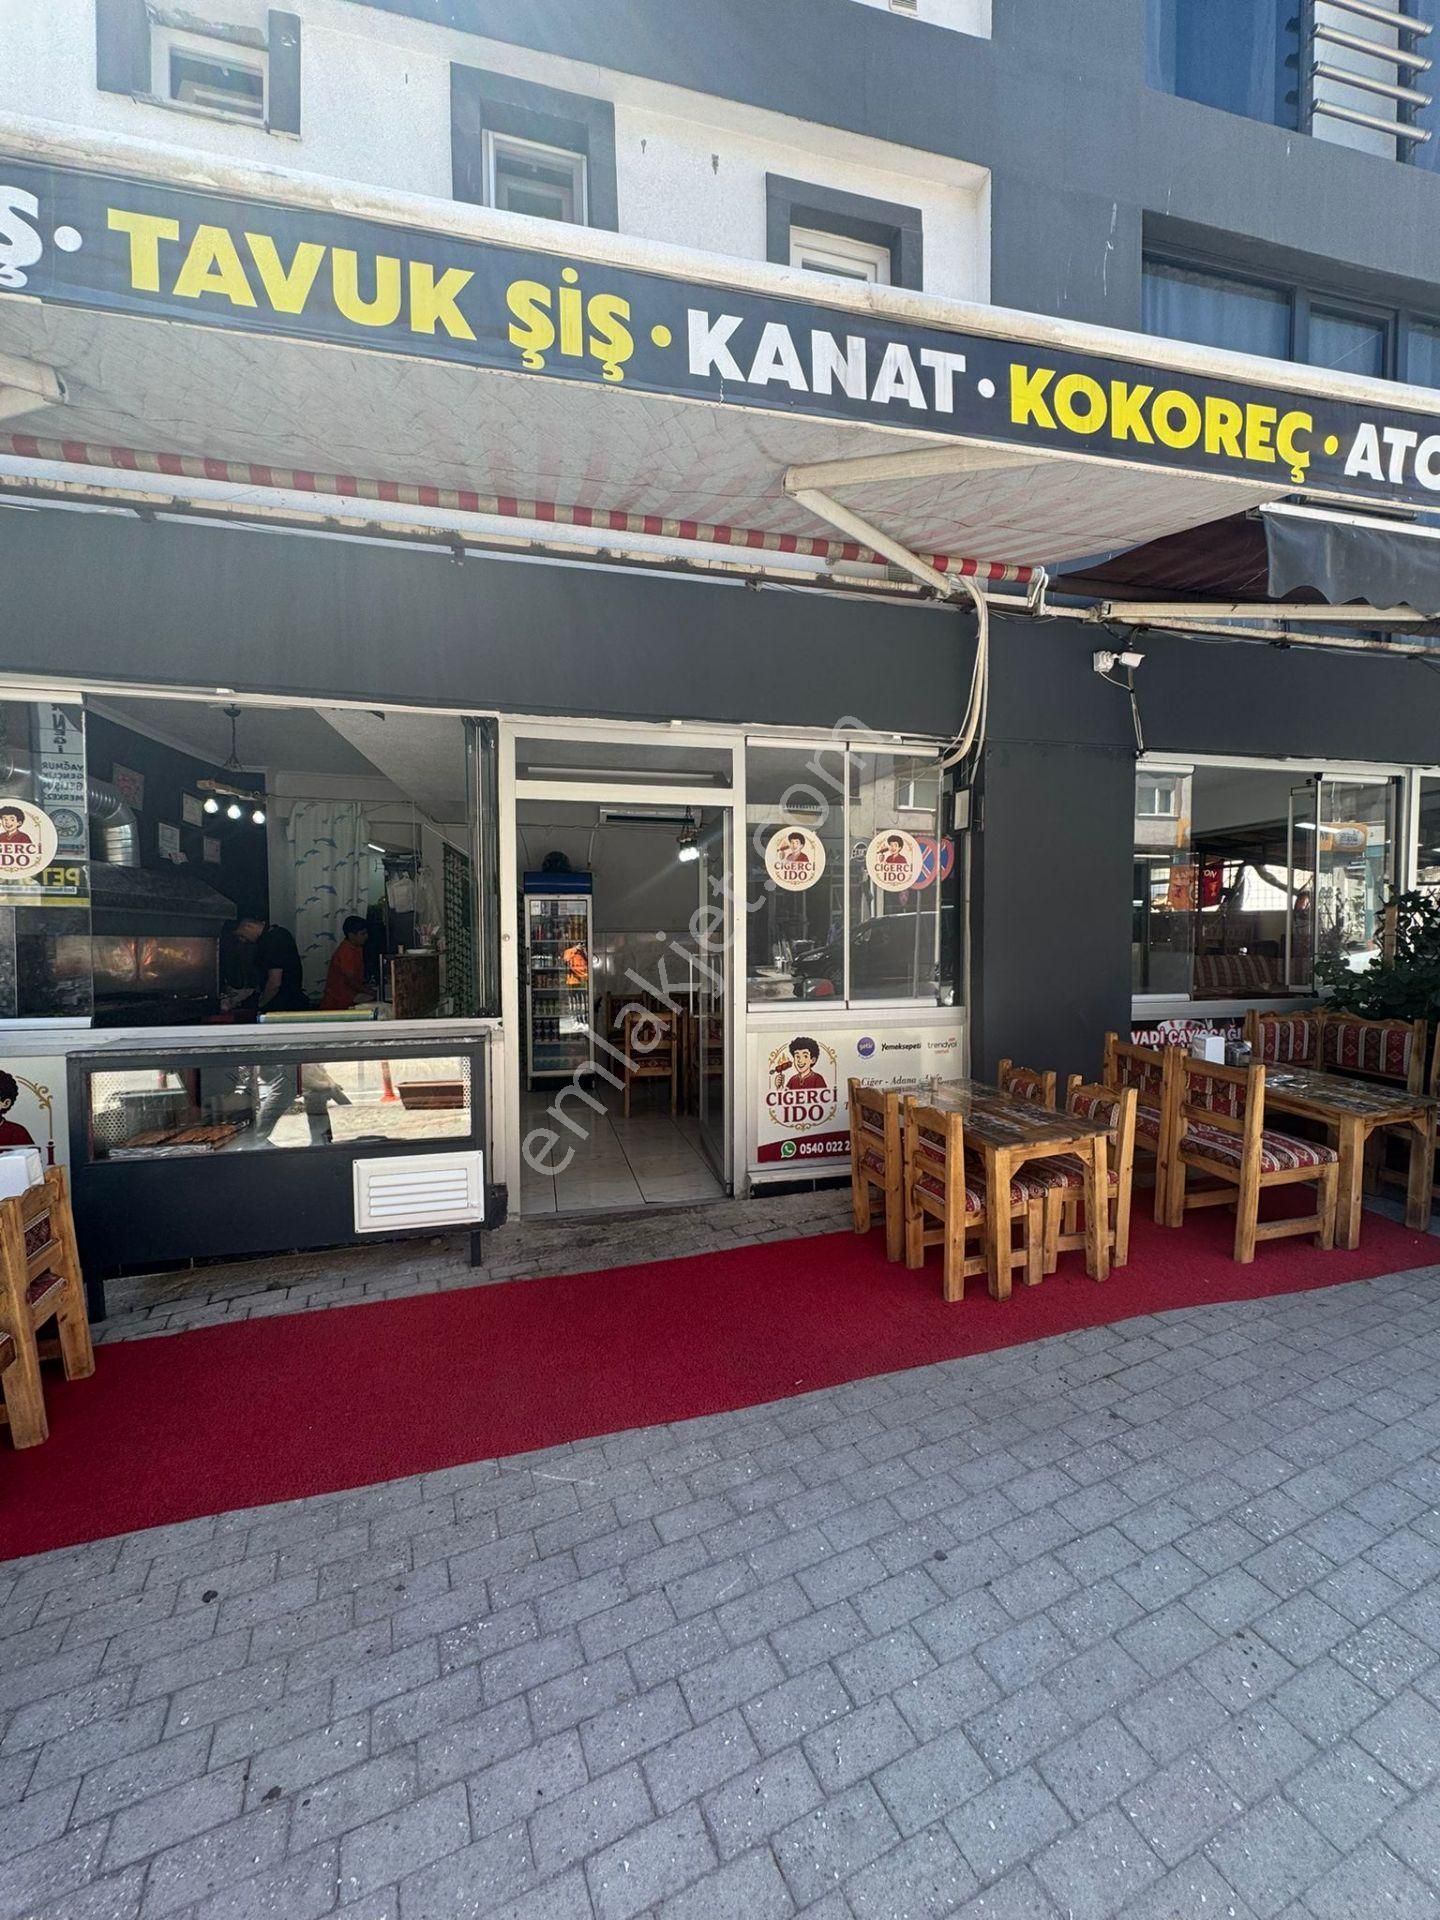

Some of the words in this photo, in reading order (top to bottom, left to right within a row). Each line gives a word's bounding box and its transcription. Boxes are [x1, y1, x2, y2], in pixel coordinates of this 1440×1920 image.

[107, 208, 478, 342] TAVUK
[506, 267, 635, 382] ŞİŞ
[688, 310, 966, 414] KANAT
[1010, 363, 1313, 483] KOKOREÇ
[1130, 1027, 1165, 1045] VADİ
[881, 1042, 922, 1051] Yemeksepeti
[783, 1104, 824, 1123] IDO
[800, 1142, 824, 1154] 0540
[826, 1141, 844, 1152] 022
